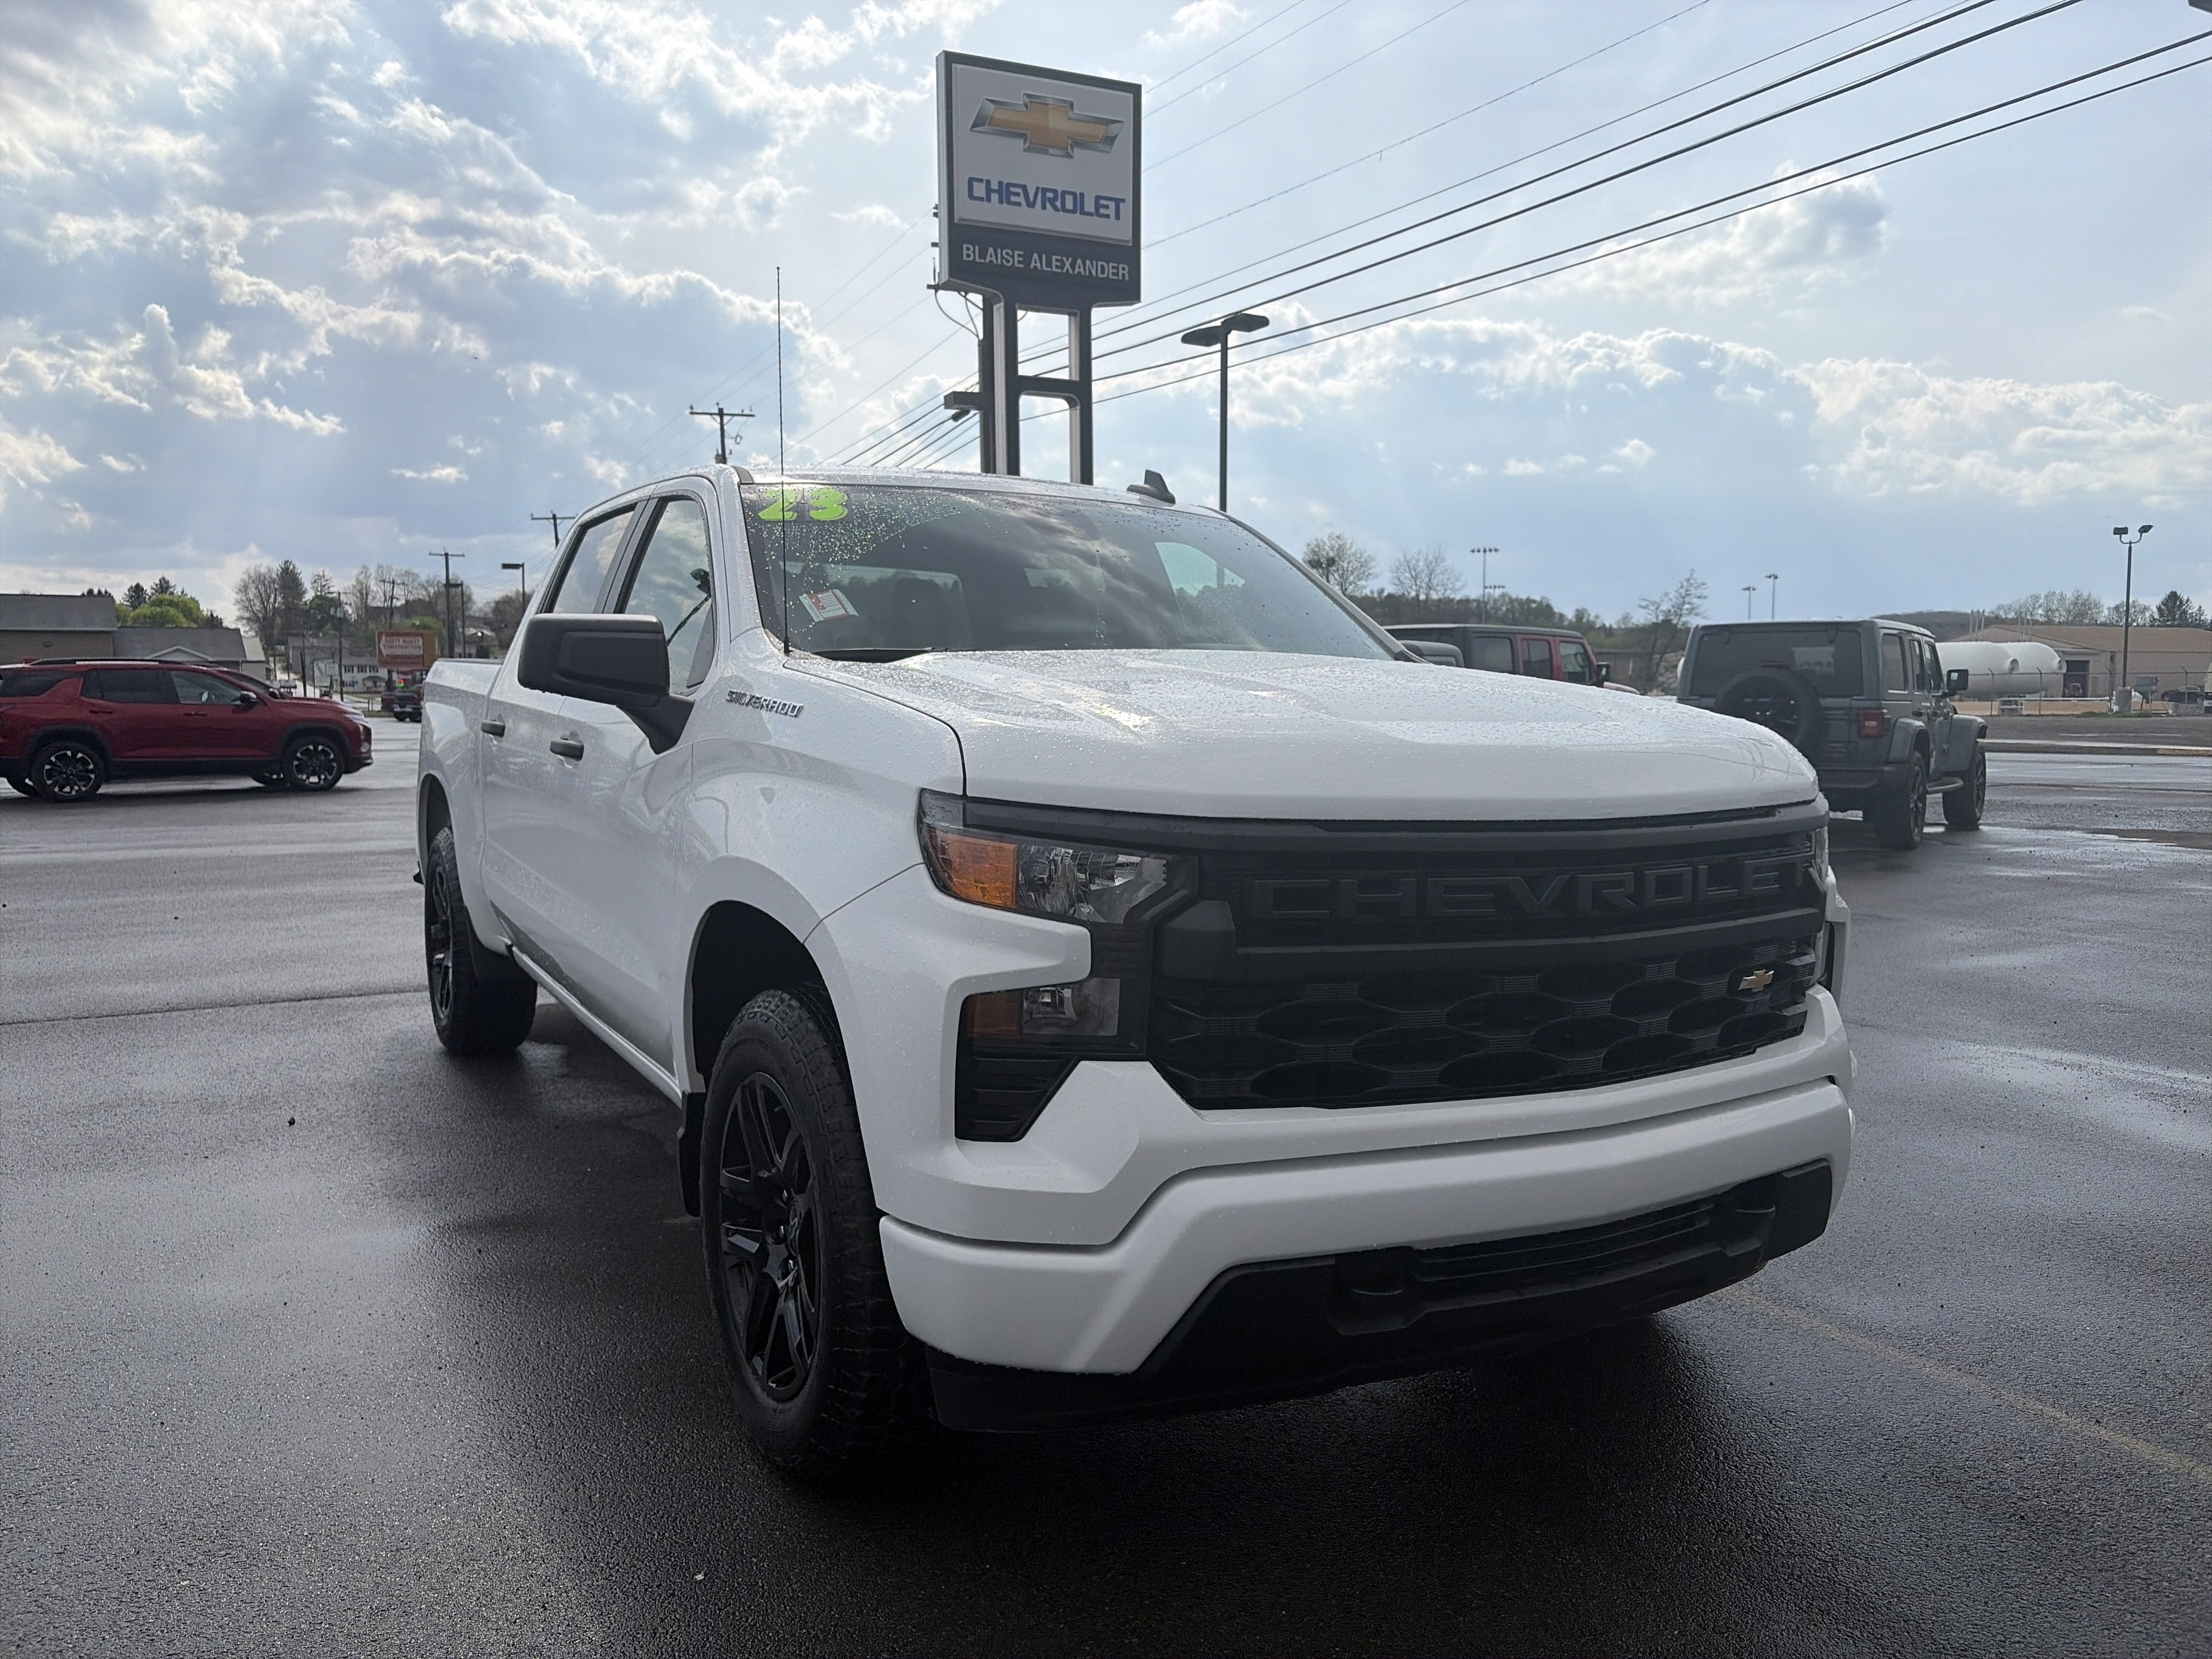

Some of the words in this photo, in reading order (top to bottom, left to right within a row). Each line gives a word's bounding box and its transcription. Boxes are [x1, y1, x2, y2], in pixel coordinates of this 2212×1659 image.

[967, 177, 1126, 221] CHEVROLET
[962, 244, 1024, 268] BLAISE
[1030, 253, 1129, 281] ALEXANDER
[758, 487, 848, 521] 23
[726, 690, 804, 718] SILVERADO
